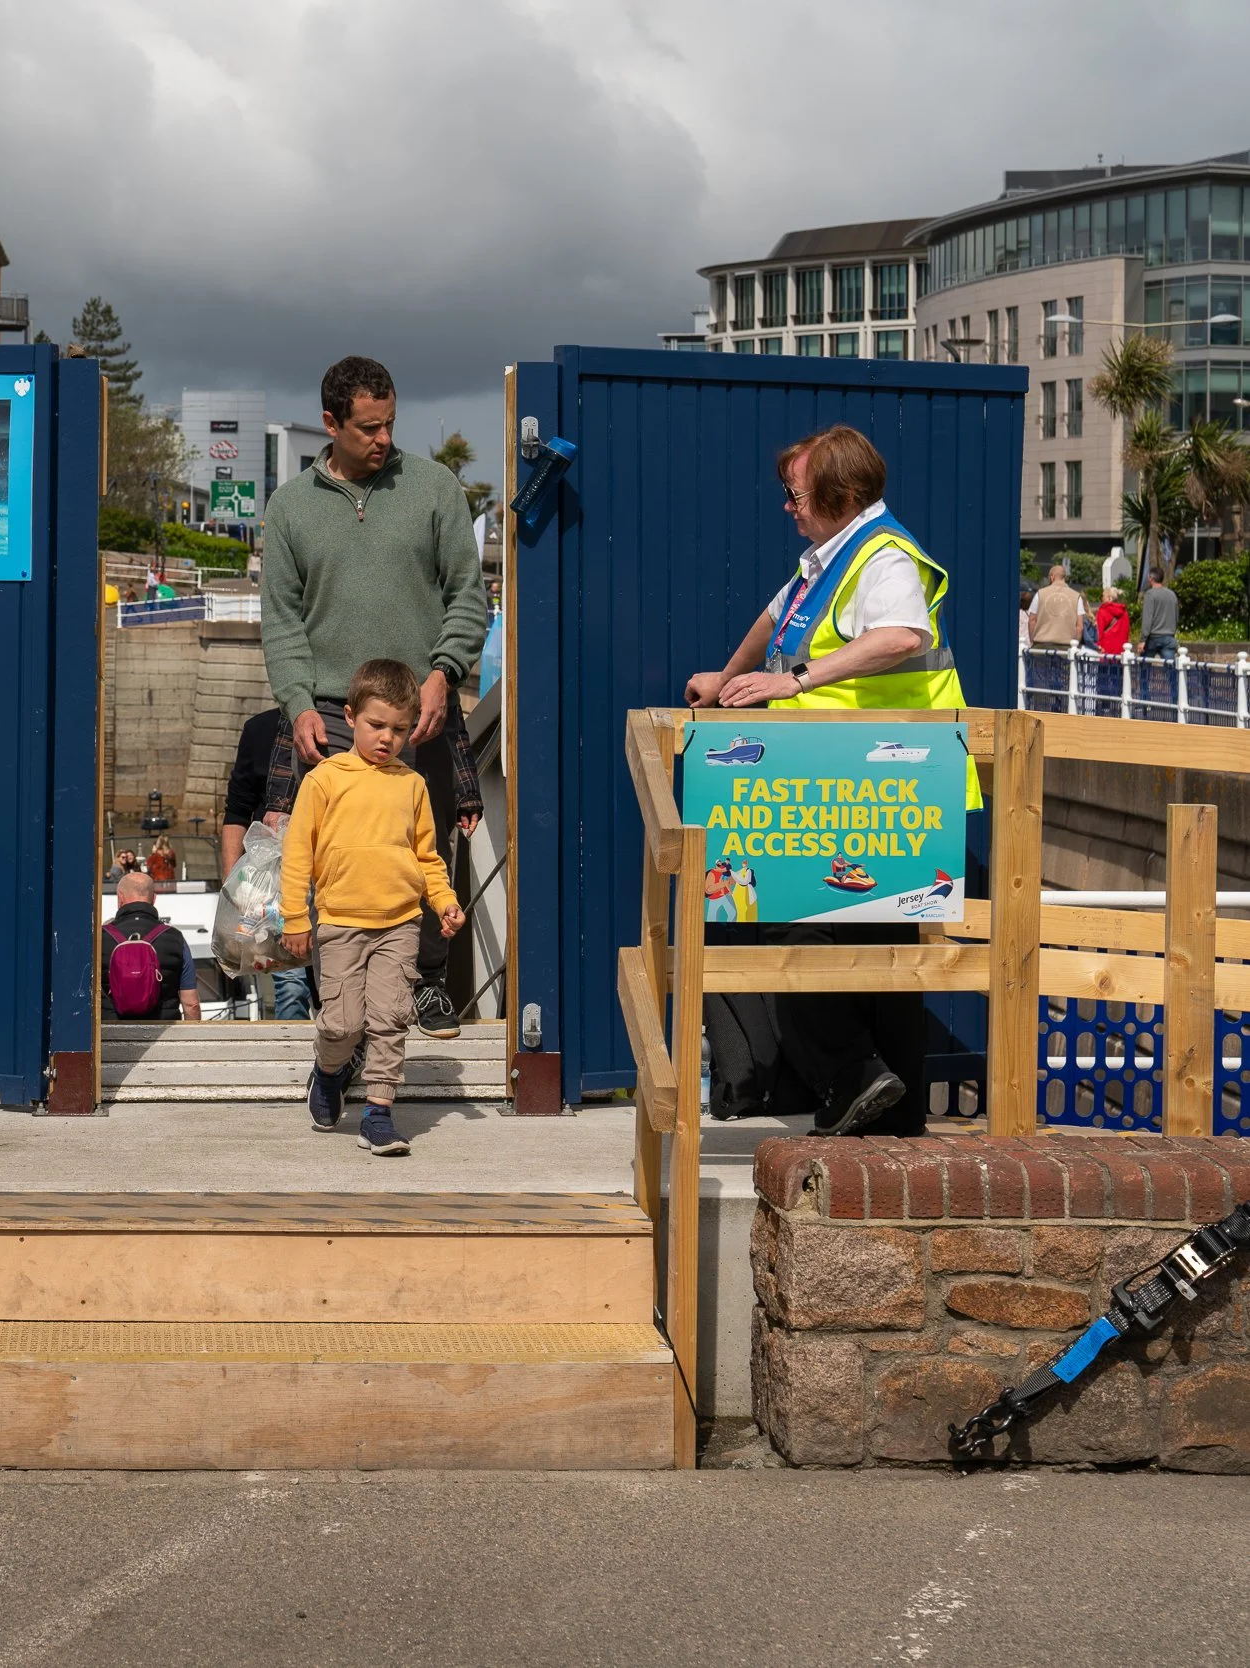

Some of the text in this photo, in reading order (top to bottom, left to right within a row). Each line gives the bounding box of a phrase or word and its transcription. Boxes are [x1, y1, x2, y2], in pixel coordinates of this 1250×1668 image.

[732, 778, 919, 803] FAST TRACK
[706, 805, 943, 830] AND EXHIBITOR
[721, 832, 928, 857] ACCESS ONLY
[897, 892, 925, 907] Jersey
[911, 899, 938, 910] BOAT SHOW
